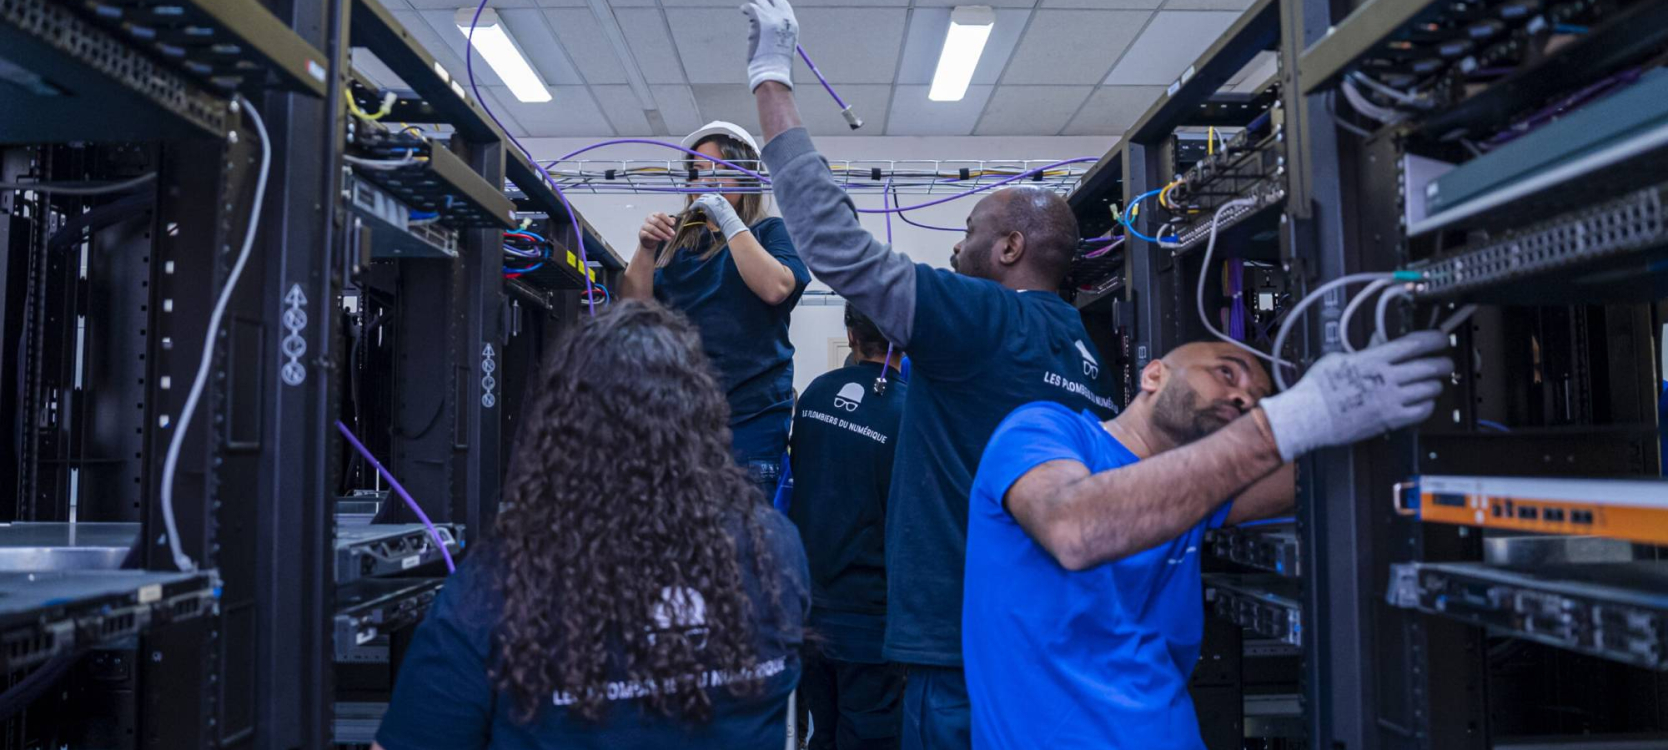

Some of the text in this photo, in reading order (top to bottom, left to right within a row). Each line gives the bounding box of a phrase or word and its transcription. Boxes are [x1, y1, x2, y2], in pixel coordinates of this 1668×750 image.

[1043, 371, 1061, 386] LES
[838, 419, 849, 429] DU
[849, 422, 888, 444] NUMÉRIQUE
